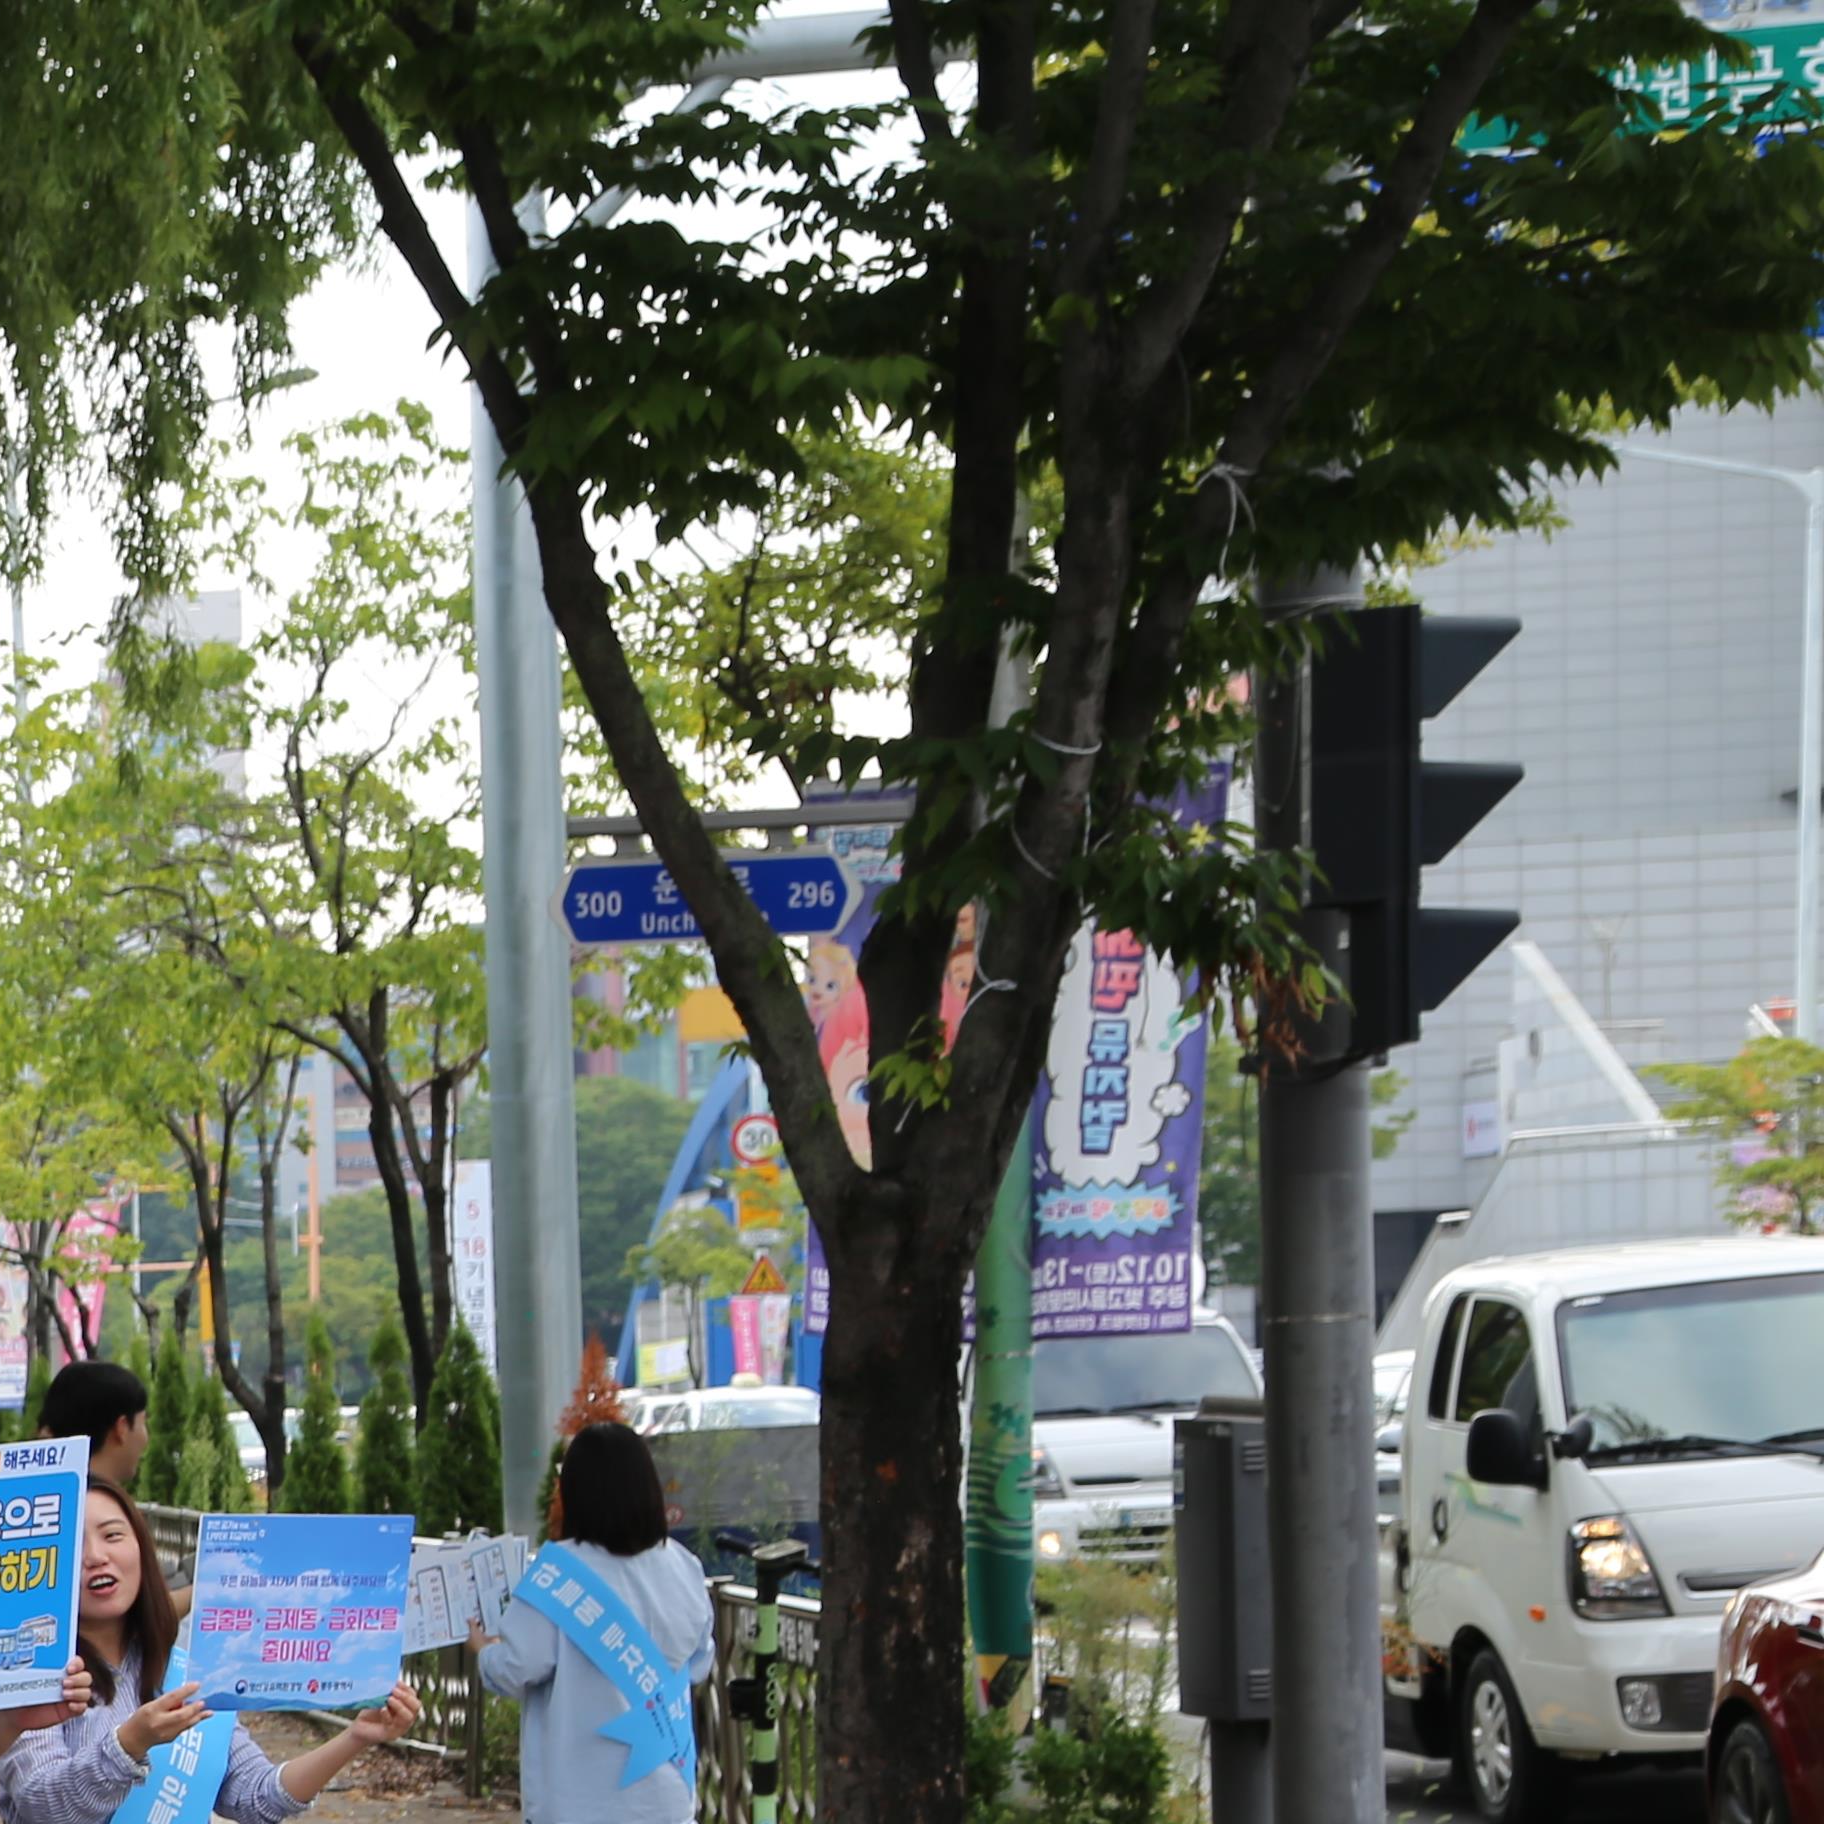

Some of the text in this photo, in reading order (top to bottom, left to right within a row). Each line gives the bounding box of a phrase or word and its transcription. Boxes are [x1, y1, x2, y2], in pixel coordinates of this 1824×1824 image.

[575, 891, 623, 918] 300
[788, 881, 835, 908] 296
[3, 1446, 66, 1470] 해주세요!
[262, 1640, 331, 1662] 줄이세요
